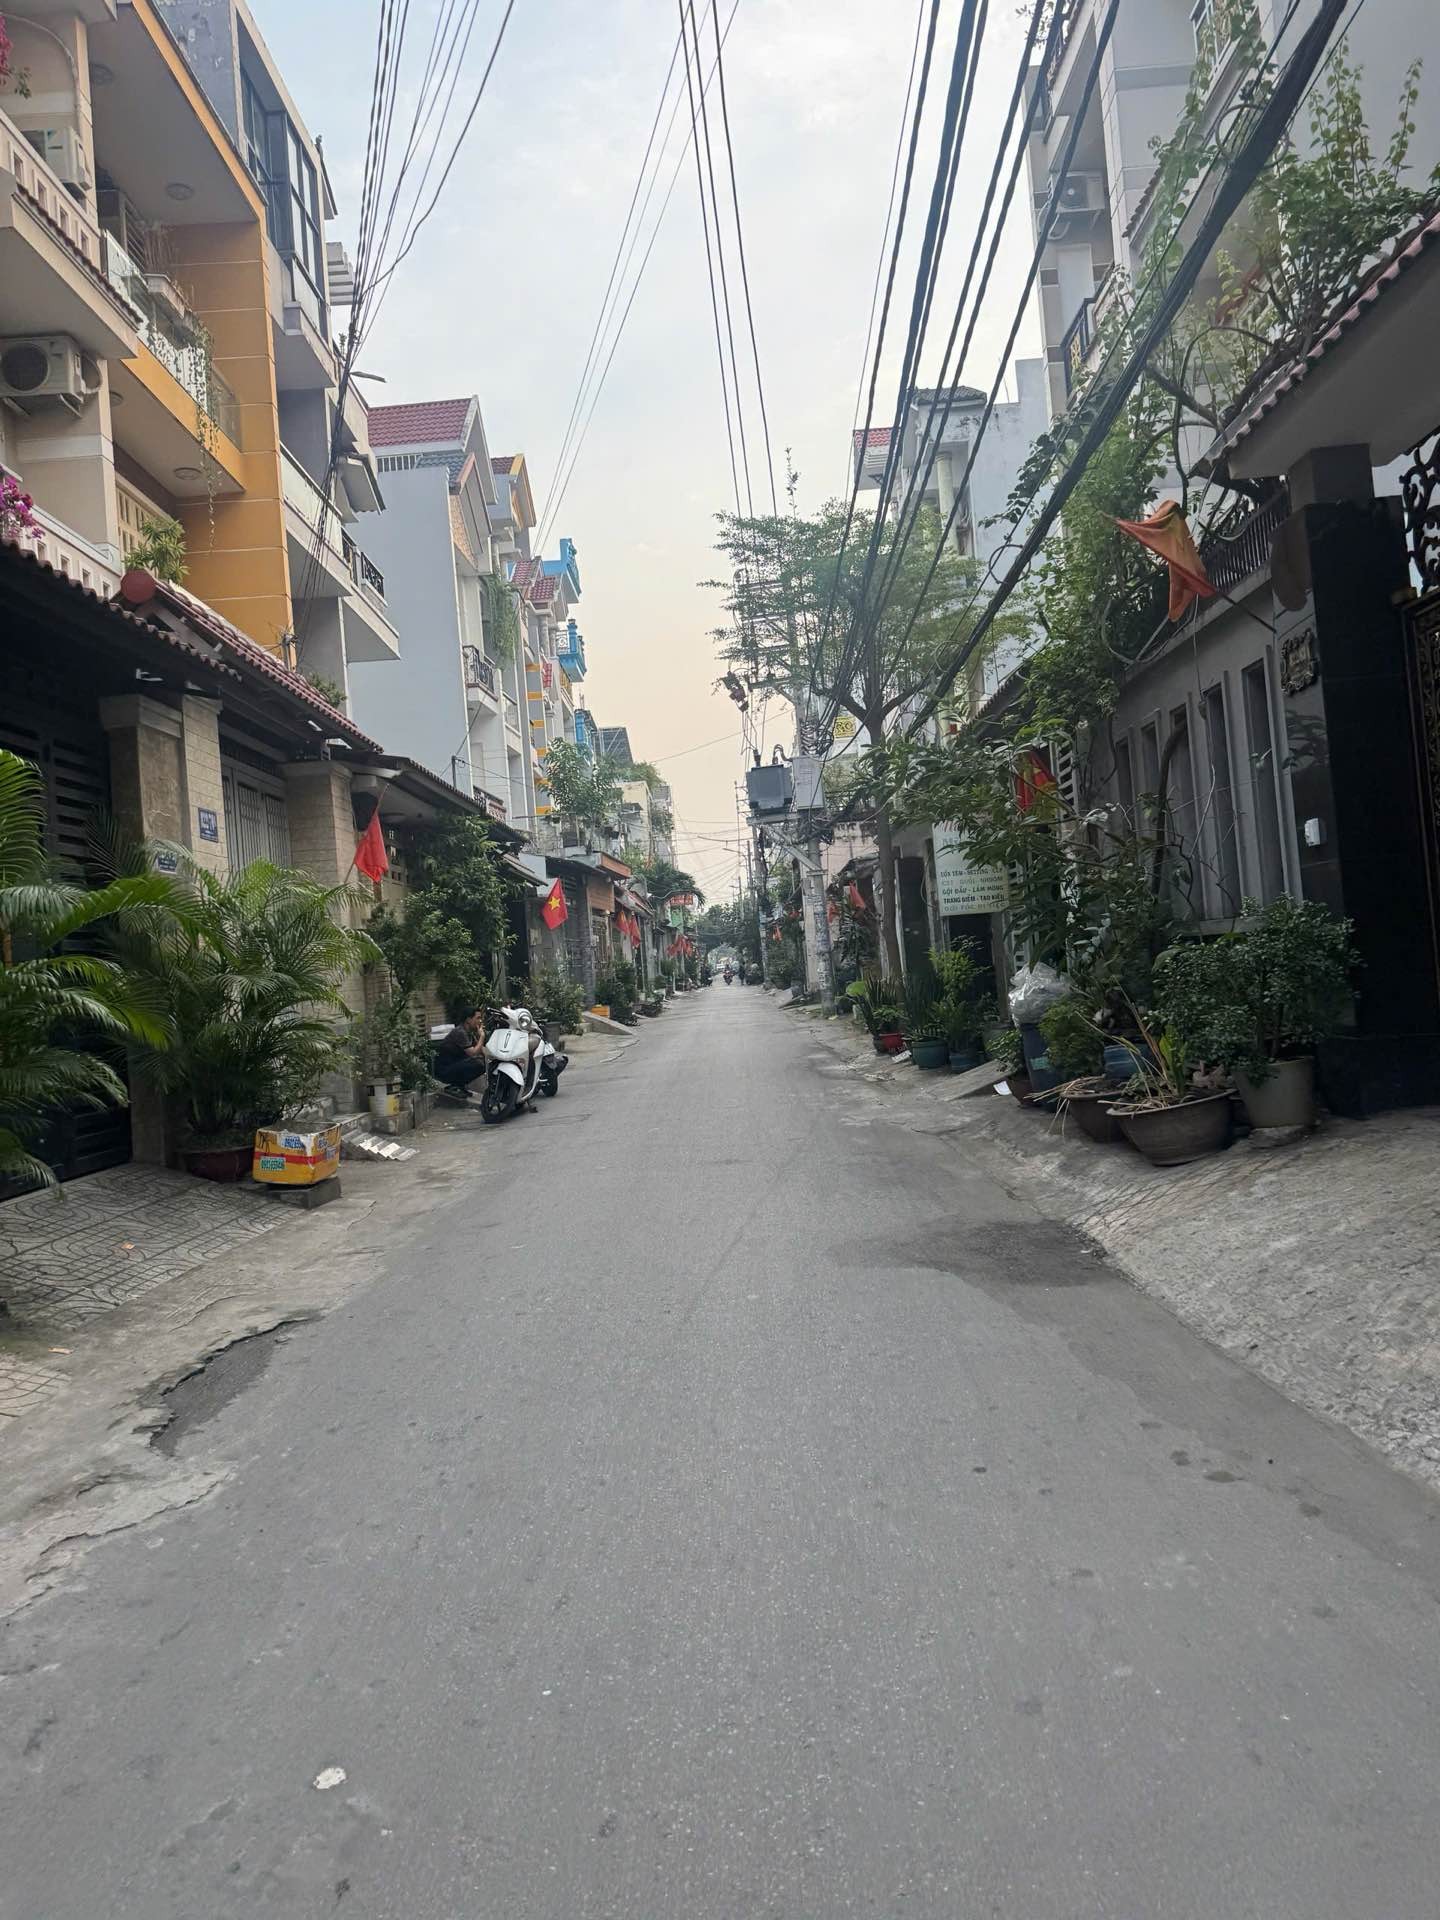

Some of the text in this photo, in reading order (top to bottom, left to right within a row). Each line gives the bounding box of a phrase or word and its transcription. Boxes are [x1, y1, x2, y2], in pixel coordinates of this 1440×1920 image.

[942, 886, 953, 896] GỘI
[954, 885, 967, 894] ĐẦU
[944, 896, 961, 904] TRANG
